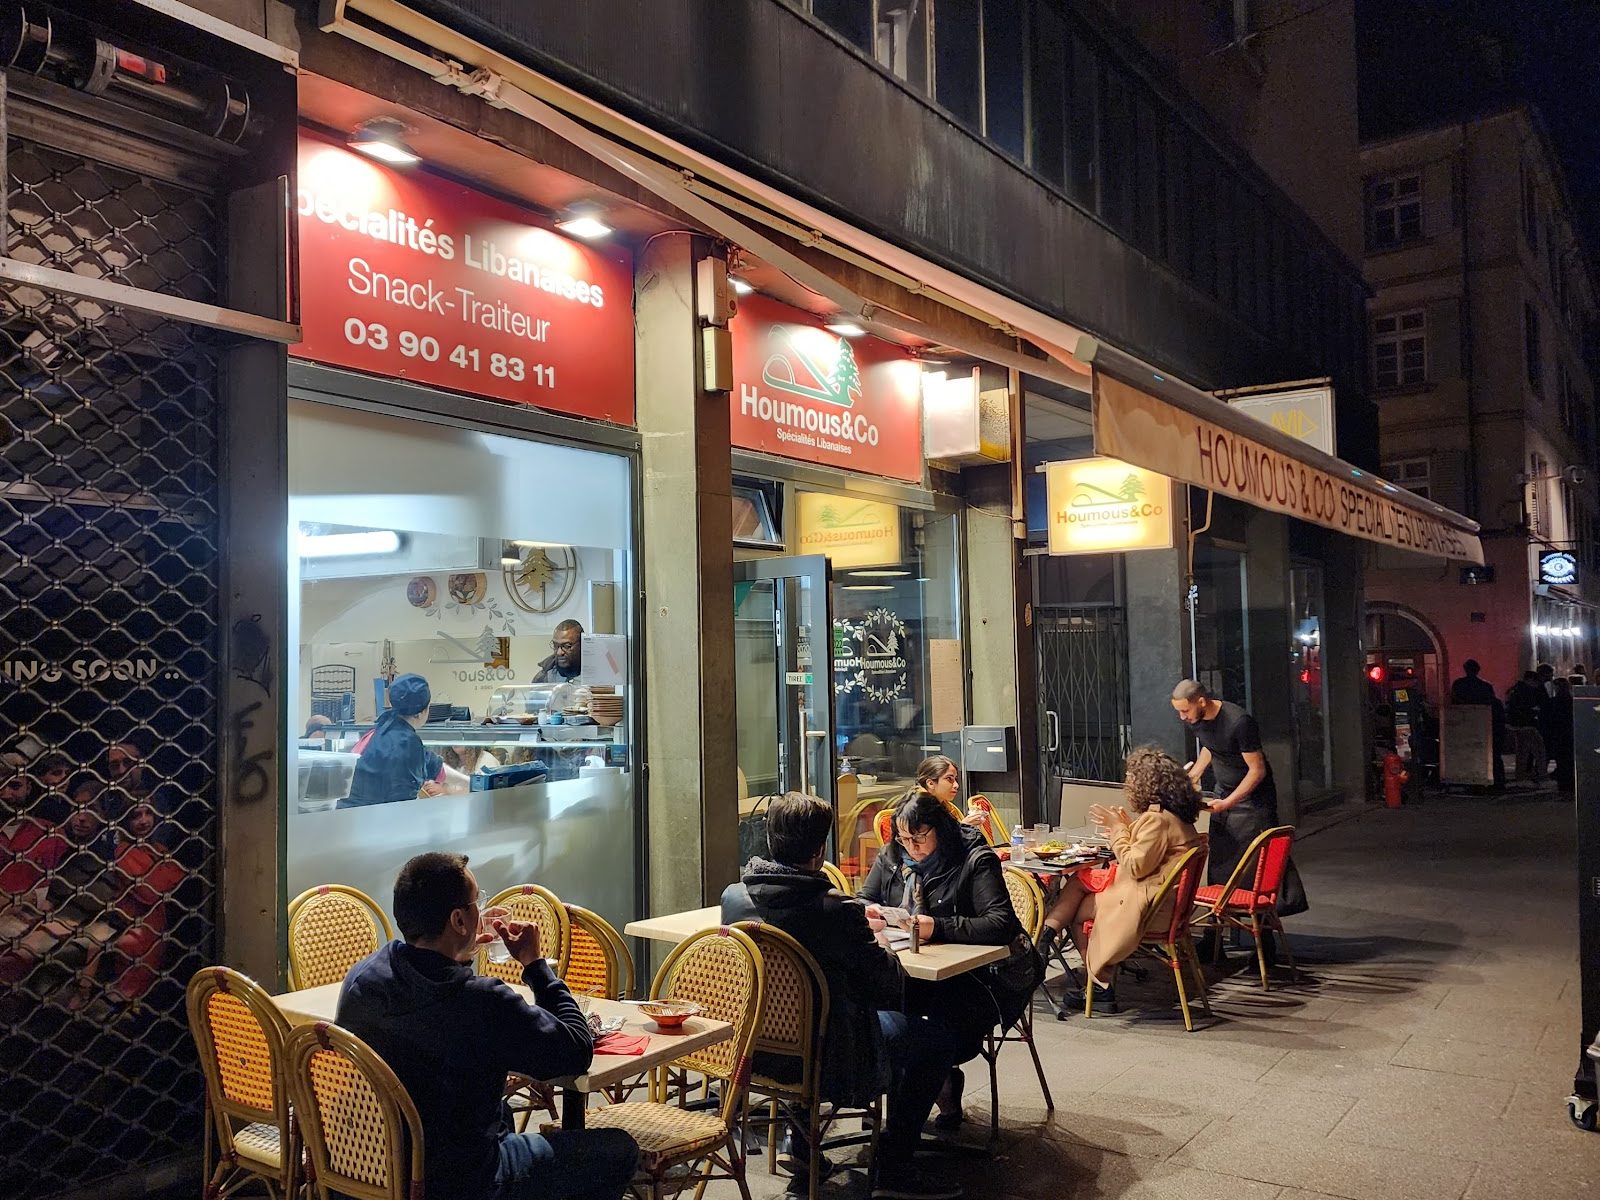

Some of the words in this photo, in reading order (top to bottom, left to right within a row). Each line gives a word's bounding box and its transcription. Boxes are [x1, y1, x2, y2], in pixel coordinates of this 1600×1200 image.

[348, 257, 551, 342] Snack-Traiteur
[464, 234, 605, 308] Libanaises
[344, 317, 388, 350] 03
[399, 330, 440, 362] 90
[449, 344, 480, 372] 41
[490, 353, 525, 382] 83
[533, 363, 555, 388] 11
[740, 383, 879, 446] Houmous&Co
[777, 427, 816, 448] Spécialités
[816, 436, 852, 455] Libanaises
[1197, 425, 1297, 510] HOUMOUS
[1300, 469, 1312, 514] &
[1314, 475, 1336, 522] CO
[1057, 503, 1163, 524] Houmous&Co
[860, 656, 906, 670] Houmous&Co
